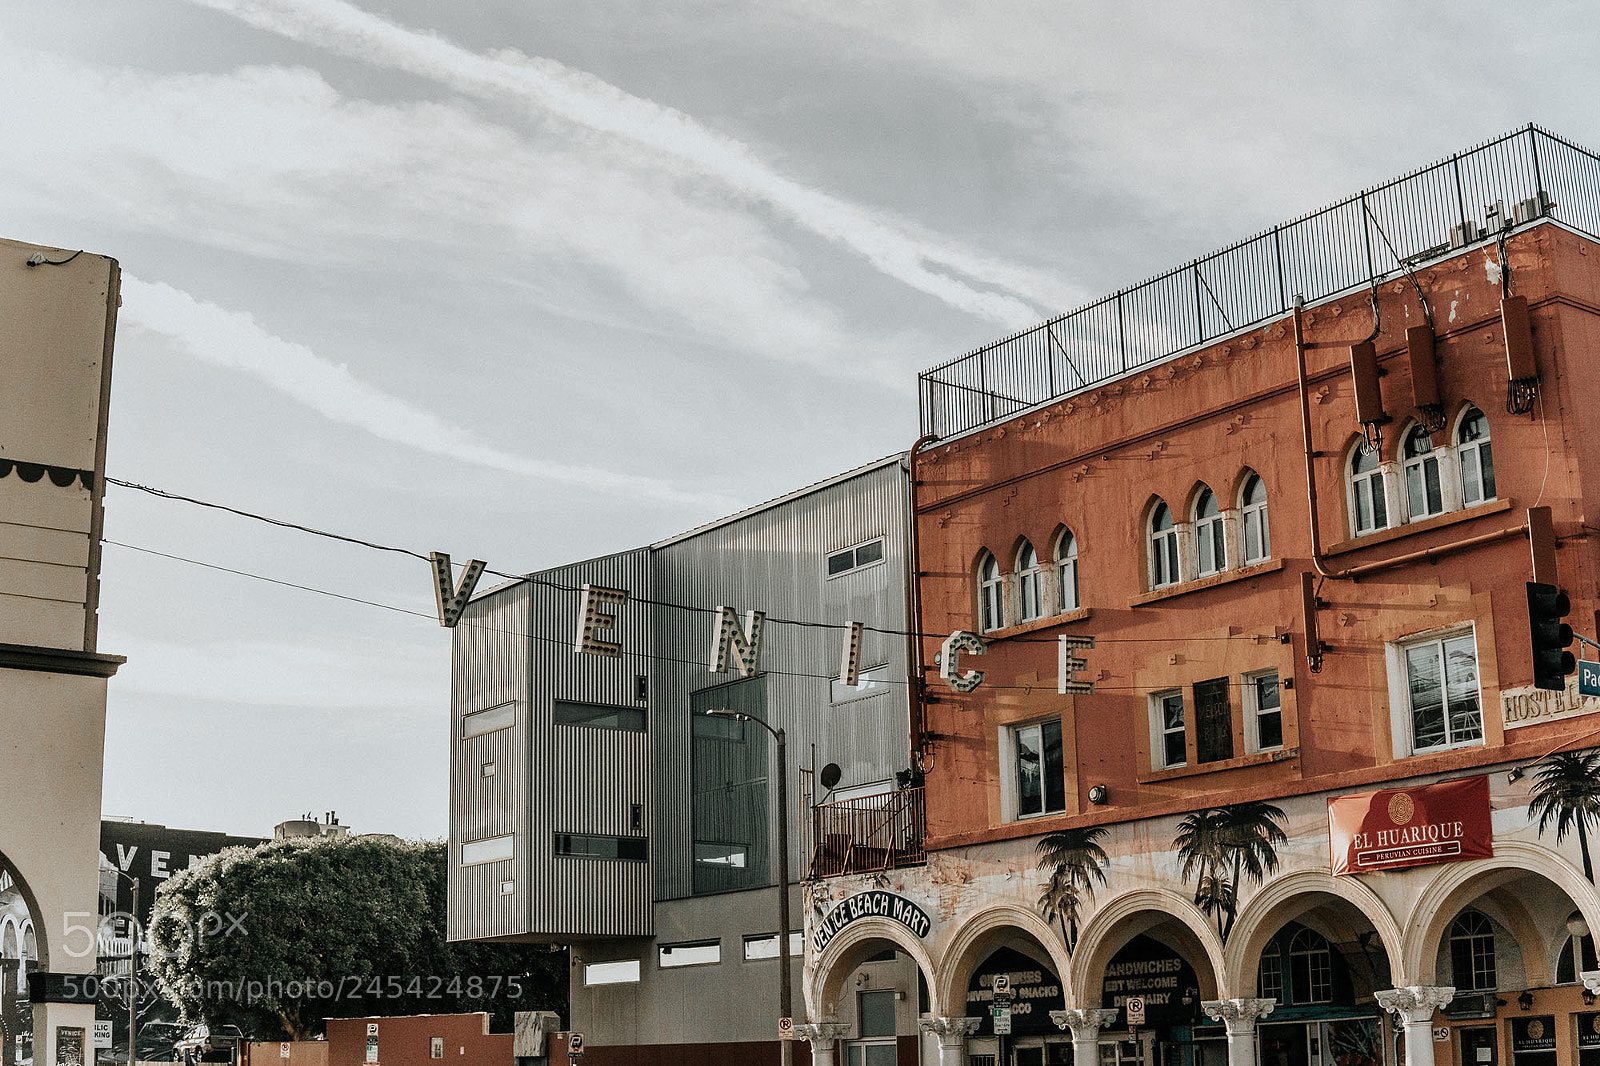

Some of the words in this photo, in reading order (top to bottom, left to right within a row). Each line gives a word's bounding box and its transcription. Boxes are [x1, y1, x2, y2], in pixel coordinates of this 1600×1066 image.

[428, 551, 1096, 695] VENICE
[1353, 833, 1373, 850] EL
[1377, 821, 1464, 847] HUARIQUE
[1376, 850, 1411, 860] PERUVIAN
[1413, 846, 1443, 855] CUISINE
[849, 893, 889, 919] BEACH
[893, 897, 929, 937] MART
[979, 970, 1042, 987] GRERIES
[1127, 976, 1178, 990] WELCOME
[1019, 985, 1059, 999] SNACKS
